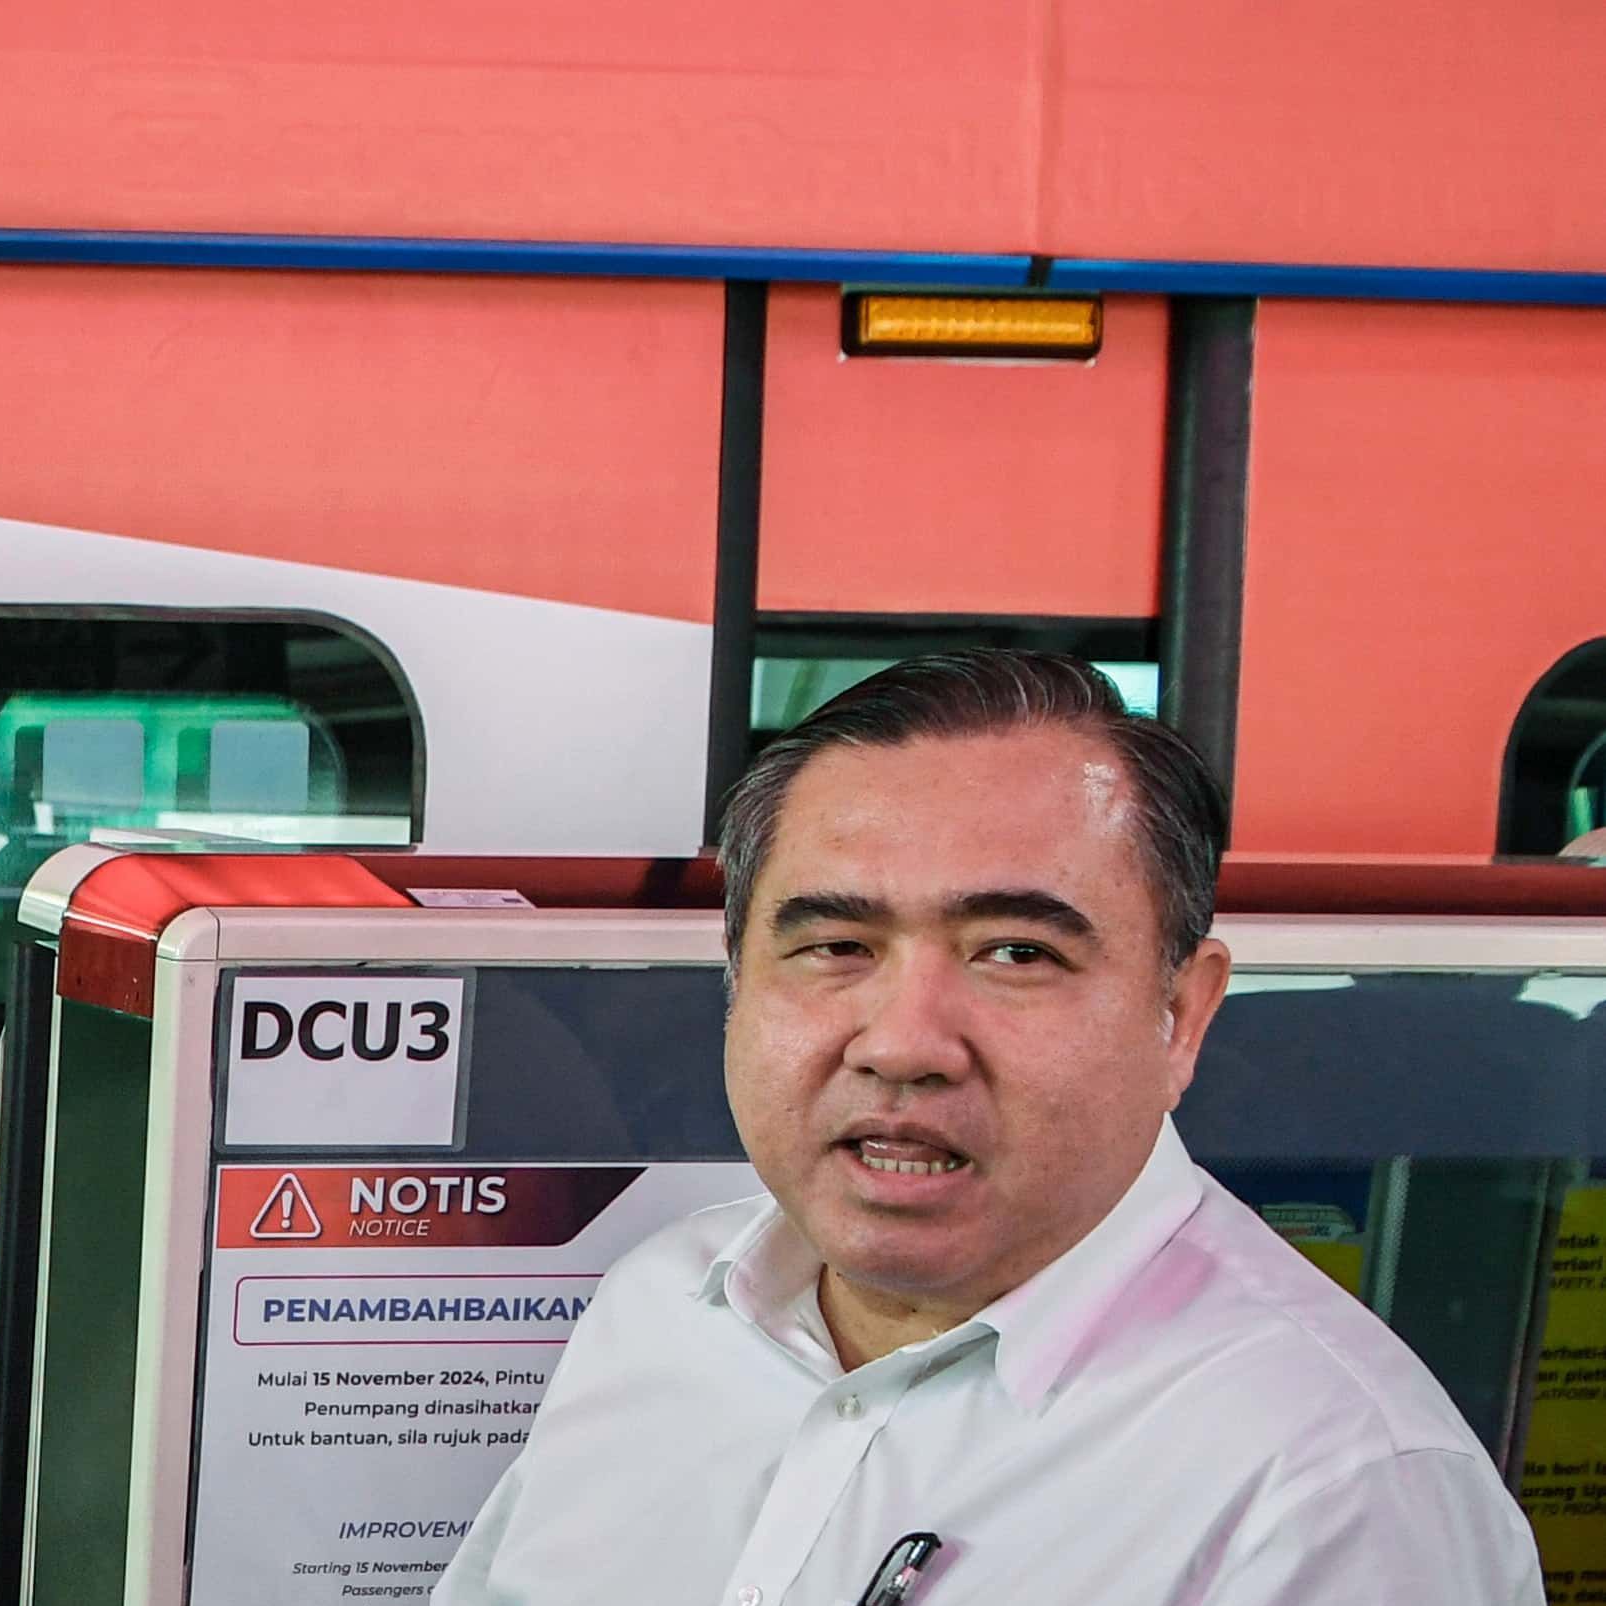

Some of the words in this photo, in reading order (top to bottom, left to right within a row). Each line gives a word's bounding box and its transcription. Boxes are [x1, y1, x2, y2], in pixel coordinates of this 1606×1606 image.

[241, 1000, 451, 1062] DCU3
[349, 1175, 507, 1215] NOTIS
[348, 1218, 431, 1237] NOTICE
[257, 1370, 308, 1387] Mulai
[313, 1371, 331, 1386] 15
[336, 1370, 434, 1387] November
[440, 1370, 489, 1388] 2024,
[495, 1369, 545, 1386] Pintu
[304, 1401, 419, 1419] Penumpang
[248, 1430, 305, 1447] Untuk
[310, 1430, 393, 1449] bantuan,
[397, 1429, 430, 1446] sila
[433, 1429, 482, 1449] rujuk
[292, 1562, 352, 1577] Starting
[355, 1561, 369, 1574] 15
[372, 1560, 449, 1574] November
[341, 1584, 425, 1598] Passengers
